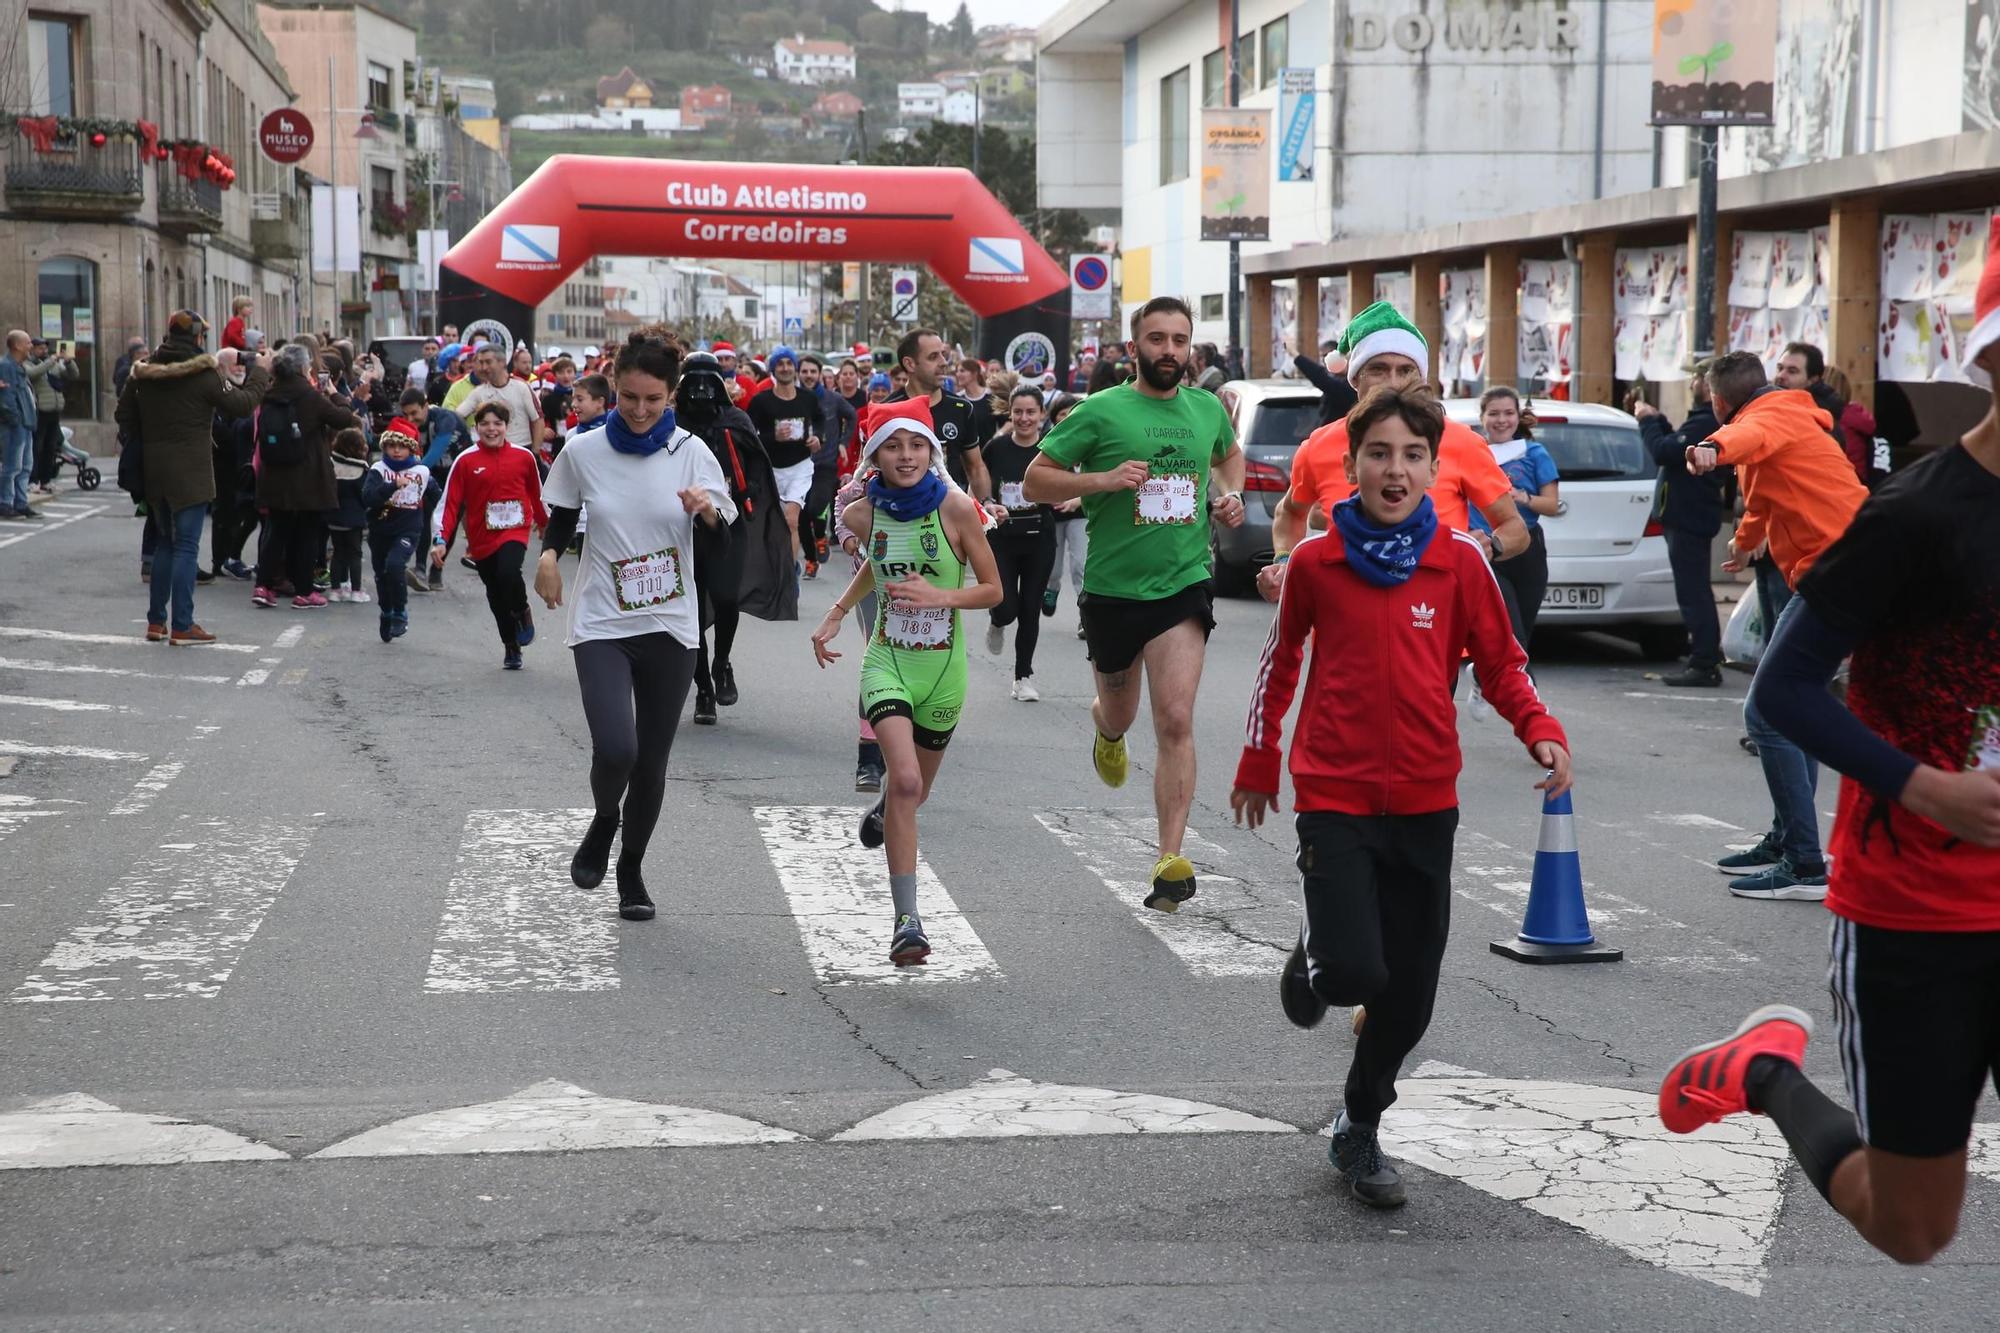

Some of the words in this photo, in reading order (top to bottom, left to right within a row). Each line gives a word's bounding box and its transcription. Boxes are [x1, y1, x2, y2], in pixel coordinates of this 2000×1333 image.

[1446, 10, 1579, 50] MAR
[266, 134, 308, 146] MUSEO
[667, 181, 728, 206] Club
[734, 184, 867, 210] Atletismo
[684, 218, 847, 244] Corredoiras
[1144, 427, 1151, 438] V
[1153, 427, 1195, 439] CARREIRA
[1147, 458, 1196, 469] CALVARIO
[384, 469, 423, 484] NASA
[1163, 498, 1172, 511] 3
[881, 562, 940, 577] IRIA
[636, 575, 662, 595] 111
[1568, 588, 1600, 604] GWD
[901, 619, 932, 635] 138
[1412, 620, 1433, 629] adidas
